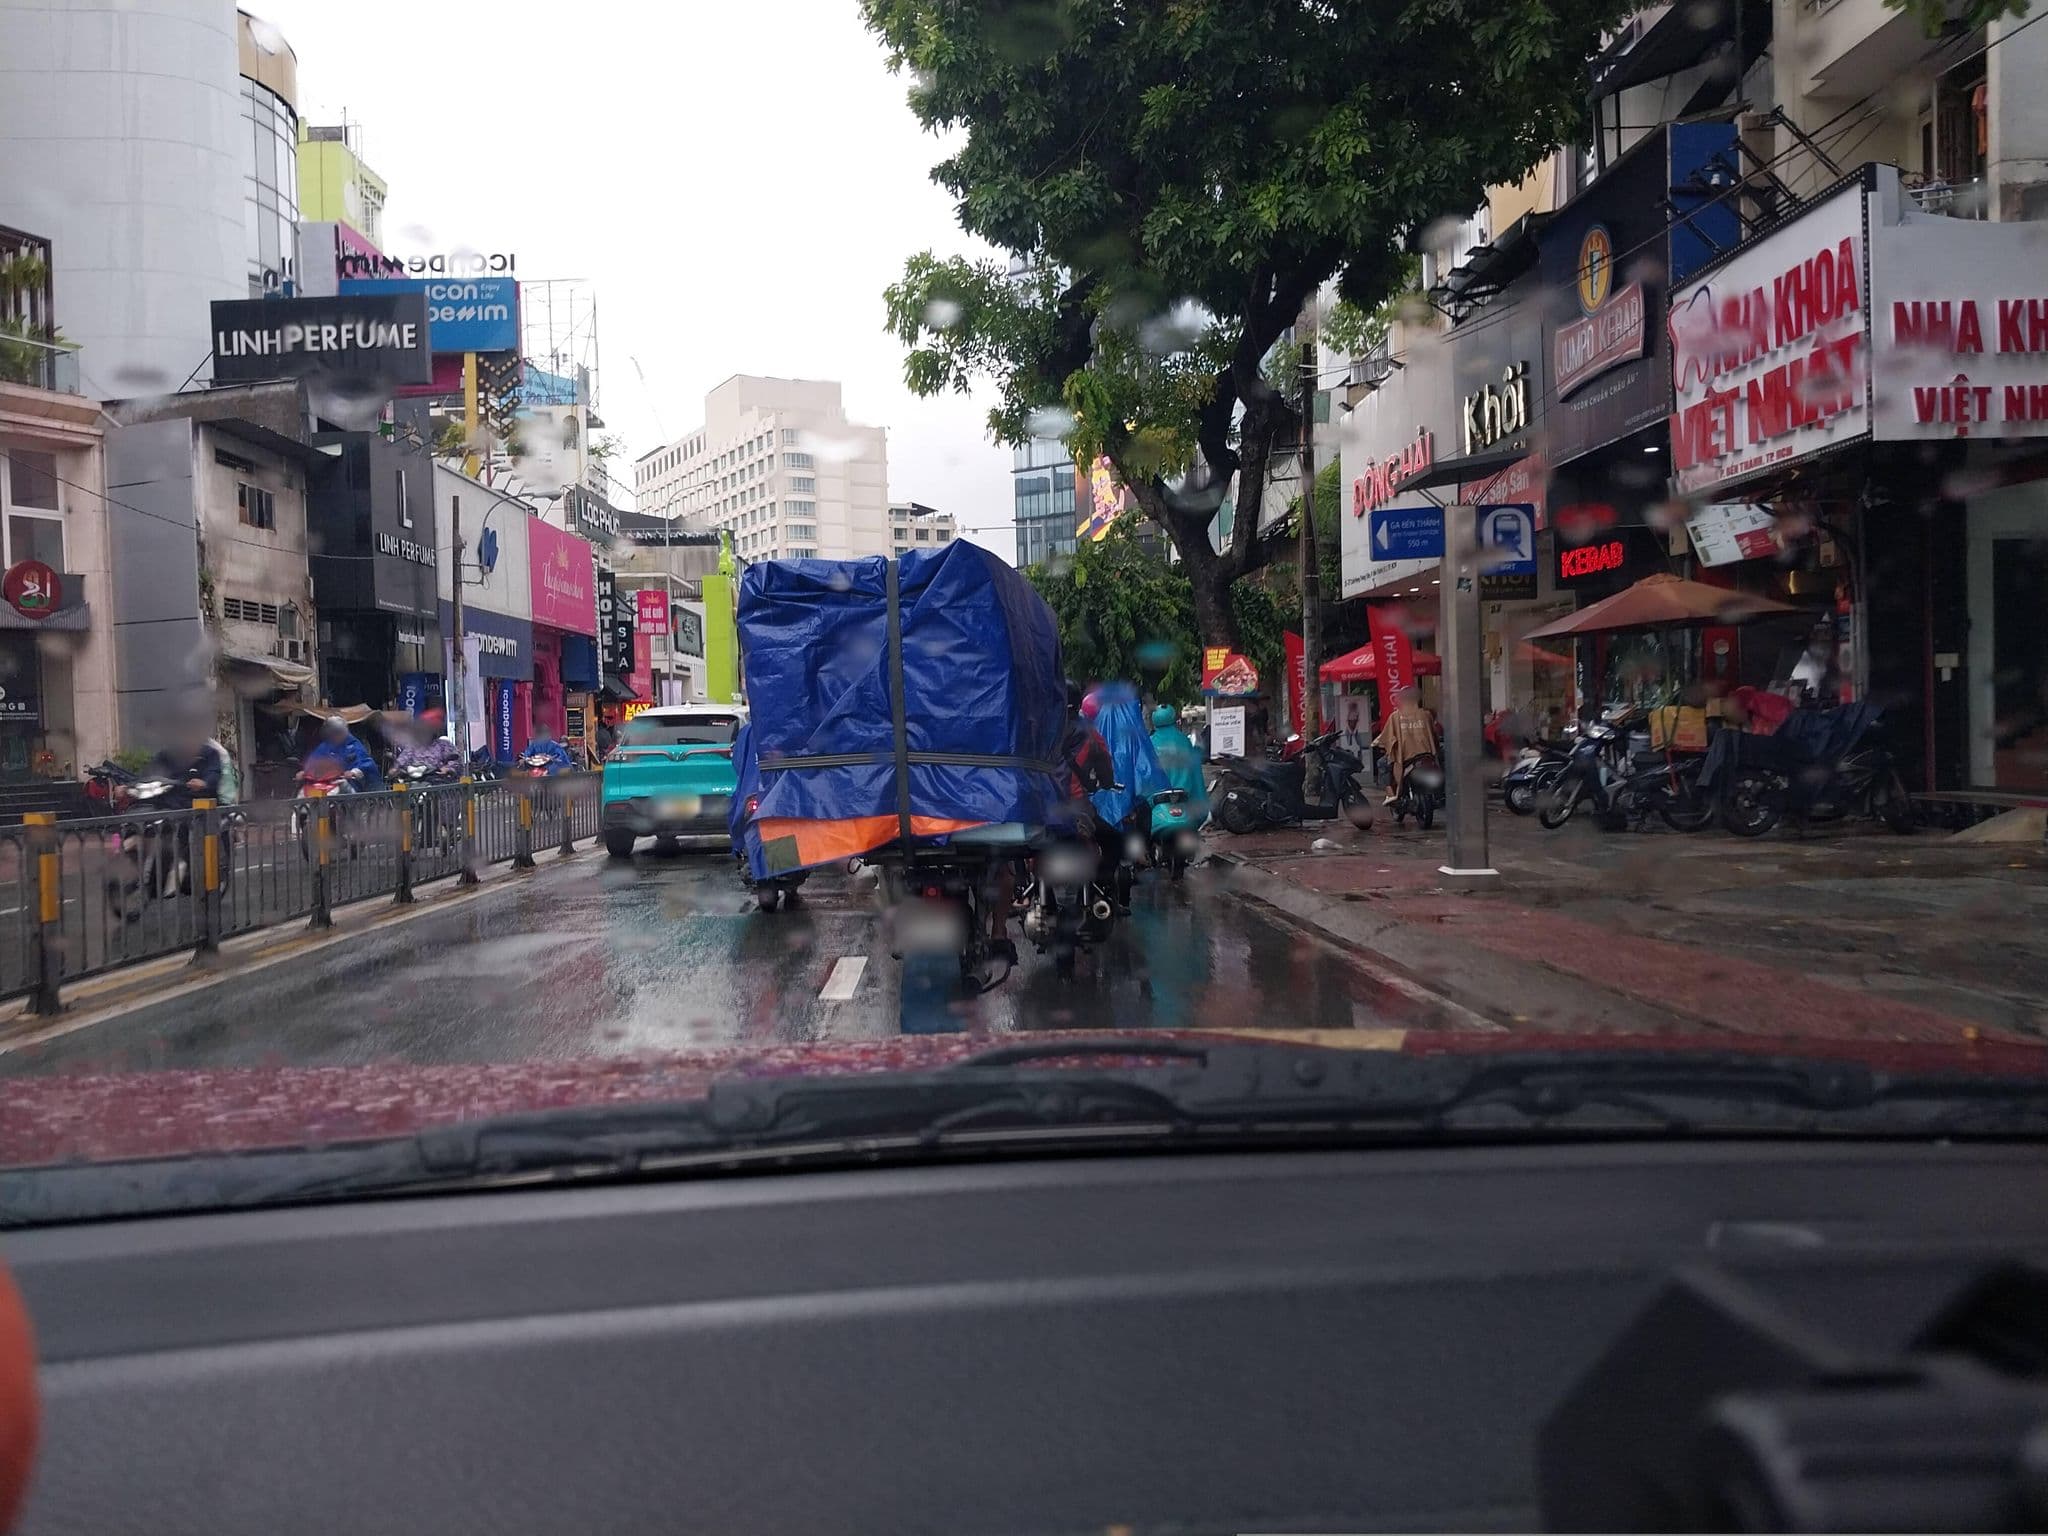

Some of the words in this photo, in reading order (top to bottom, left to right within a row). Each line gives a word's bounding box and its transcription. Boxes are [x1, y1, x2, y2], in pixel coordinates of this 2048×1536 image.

[1773, 236, 1859, 348] KHOA
[219, 330, 281, 357] LINH
[282, 323, 417, 352] PERFUME
[1559, 324, 1594, 377] JUMPO
[1599, 297, 1639, 352] KEBAB
[1894, 300, 1984, 353] NHA
[1914, 374, 1993, 437] VIỆT
[580, 496, 600, 530] LỘC
[1390, 521, 1400, 529] GA
[1401, 518, 1415, 529] BẾN
[379, 532, 400, 556] LINH
[401, 539, 435, 567] PERFUME
[1560, 542, 1624, 578] KEBAB
[600, 580, 613, 663] HOTEL
[618, 627, 628, 667] SPA
